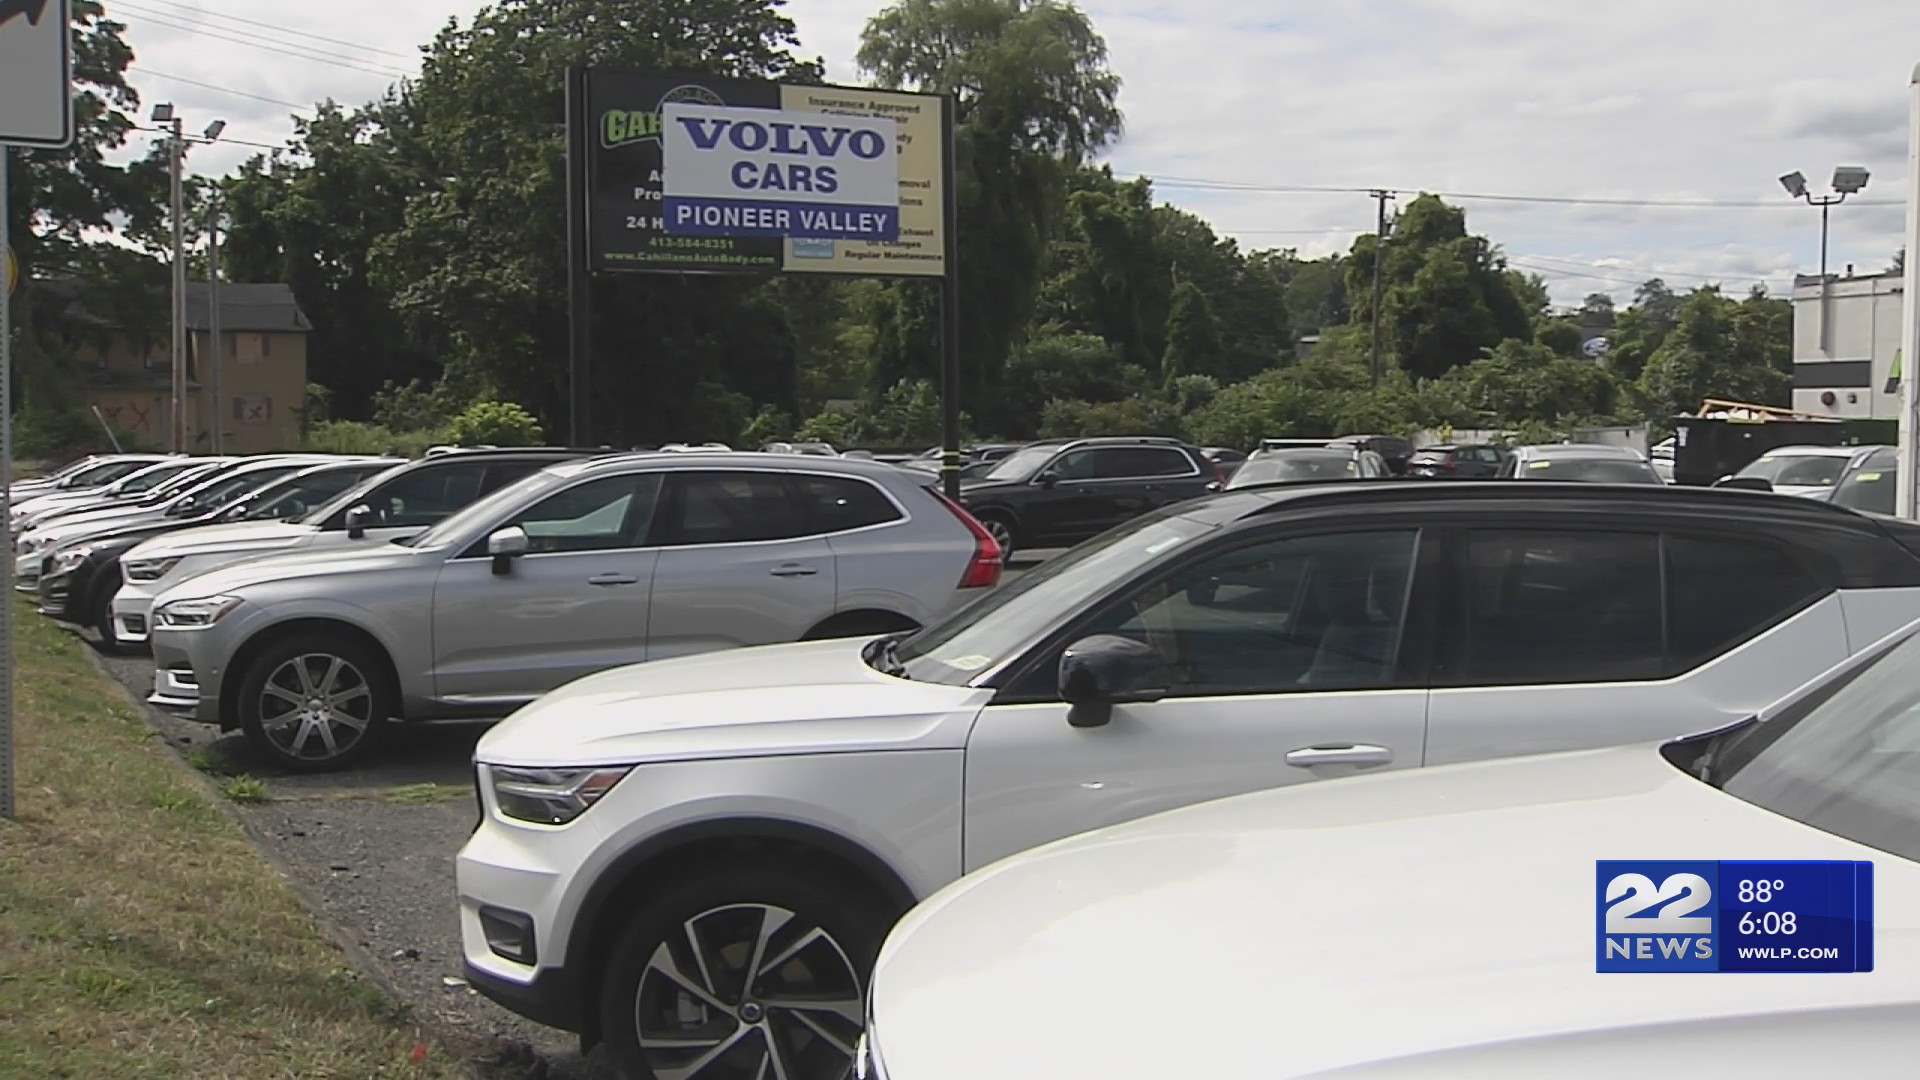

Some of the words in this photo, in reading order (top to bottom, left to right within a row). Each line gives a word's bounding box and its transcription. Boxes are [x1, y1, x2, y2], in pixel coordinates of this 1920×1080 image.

[808, 96, 865, 109] Insurance
[868, 101, 920, 114] Approved
[676, 117, 886, 159] VOLVO
[731, 161, 838, 193] CARS
[626, 216, 647, 229] 24
[677, 204, 790, 229] PIONEER
[800, 210, 887, 233] VALLEY
[845, 250, 881, 261] Regular
[884, 252, 943, 261] Maintenance
